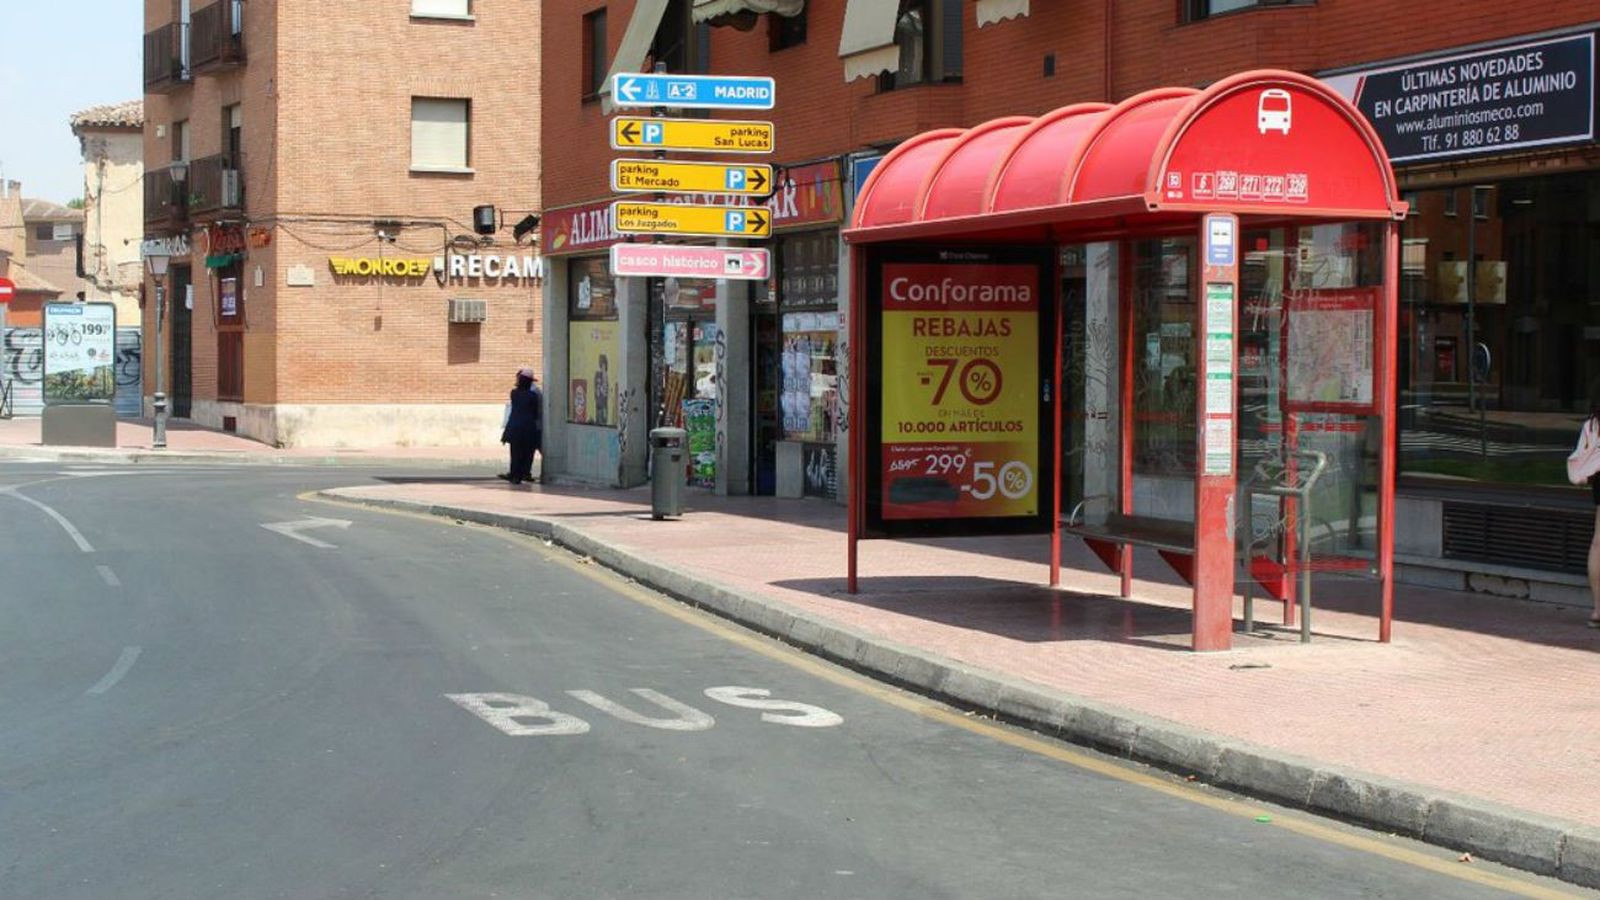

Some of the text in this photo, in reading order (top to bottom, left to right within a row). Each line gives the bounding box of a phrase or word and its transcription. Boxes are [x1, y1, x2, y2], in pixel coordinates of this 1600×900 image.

[1402, 51, 1543, 92] ÚLTIMAS NOVEDADES
[670, 84, 769, 99] A-2 MADRID
[1375, 71, 1576, 118] EN CARPINTERÍA DE ALUMINIO
[1396, 101, 1544, 135] www.aluminiosmeco.com
[646, 124, 660, 142] P
[730, 127, 769, 139] parking
[1445, 134, 1458, 149] 91
[1462, 130, 1483, 147] 880
[1487, 127, 1500, 143] 62
[1504, 124, 1519, 141] 88
[714, 137, 769, 148] San Lucas
[619, 165, 659, 176] parking
[729, 170, 743, 188] P
[619, 175, 680, 187] El Mercado
[619, 206, 659, 218] parking
[619, 217, 678, 229] Los Juzgados
[729, 213, 743, 230] P
[342, 257, 421, 277] MONROE
[619, 255, 658, 267] casco
[890, 277, 1031, 304] Conforama
[913, 317, 1012, 337] REBAJAS
[925, 345, 999, 357] DESCUENTOS
[898, 418, 1023, 433] 10.000 ARTÍCULOS
[444, 686, 843, 735] BUS
